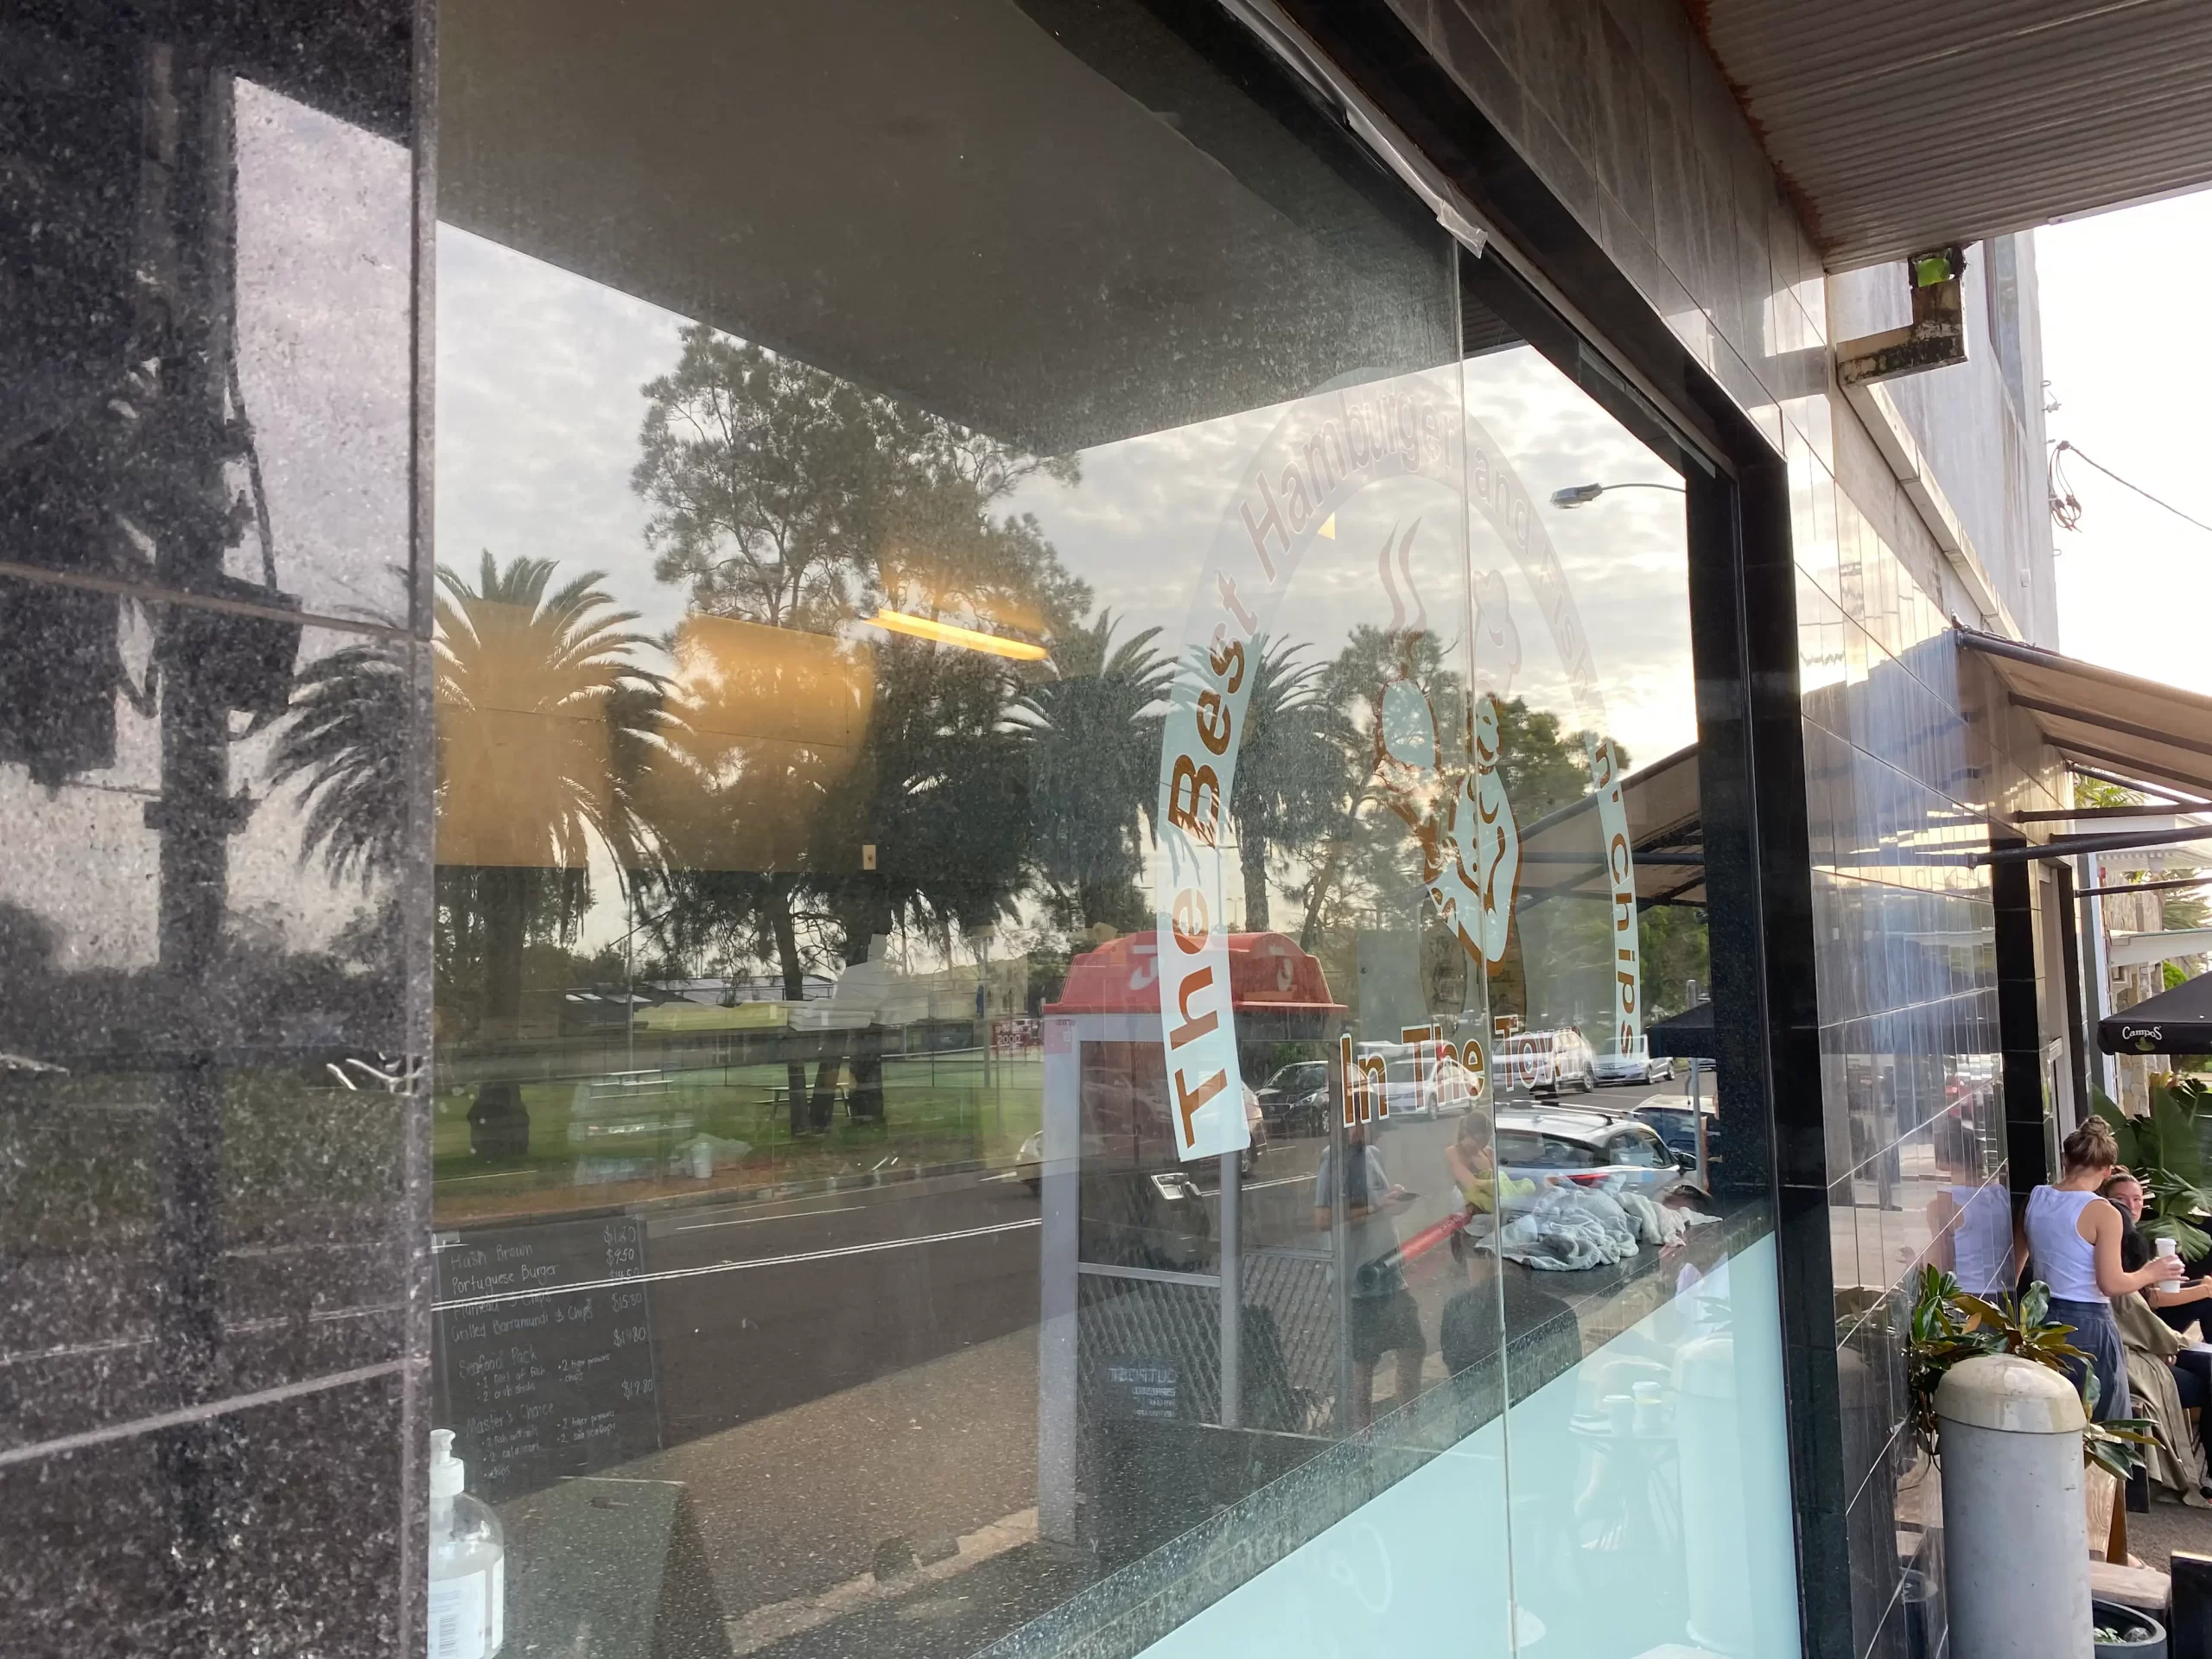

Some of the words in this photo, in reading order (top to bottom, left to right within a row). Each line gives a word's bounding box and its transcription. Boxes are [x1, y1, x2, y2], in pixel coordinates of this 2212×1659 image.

[1239, 387, 1457, 585] Hamburger
[1474, 447, 1533, 557] and
[1168, 569, 1258, 849] Best
[1169, 887, 1228, 1149] The
[1611, 833, 1636, 1060] Chips
[1339, 1033, 1390, 1128] In
[1401, 1022, 1486, 1112] The
[1494, 1014, 1586, 1093] Town
[452, 1273, 515, 1294] Portuguese
[521, 1264, 560, 1286] Burger
[496, 1244, 533, 1262] Brown
